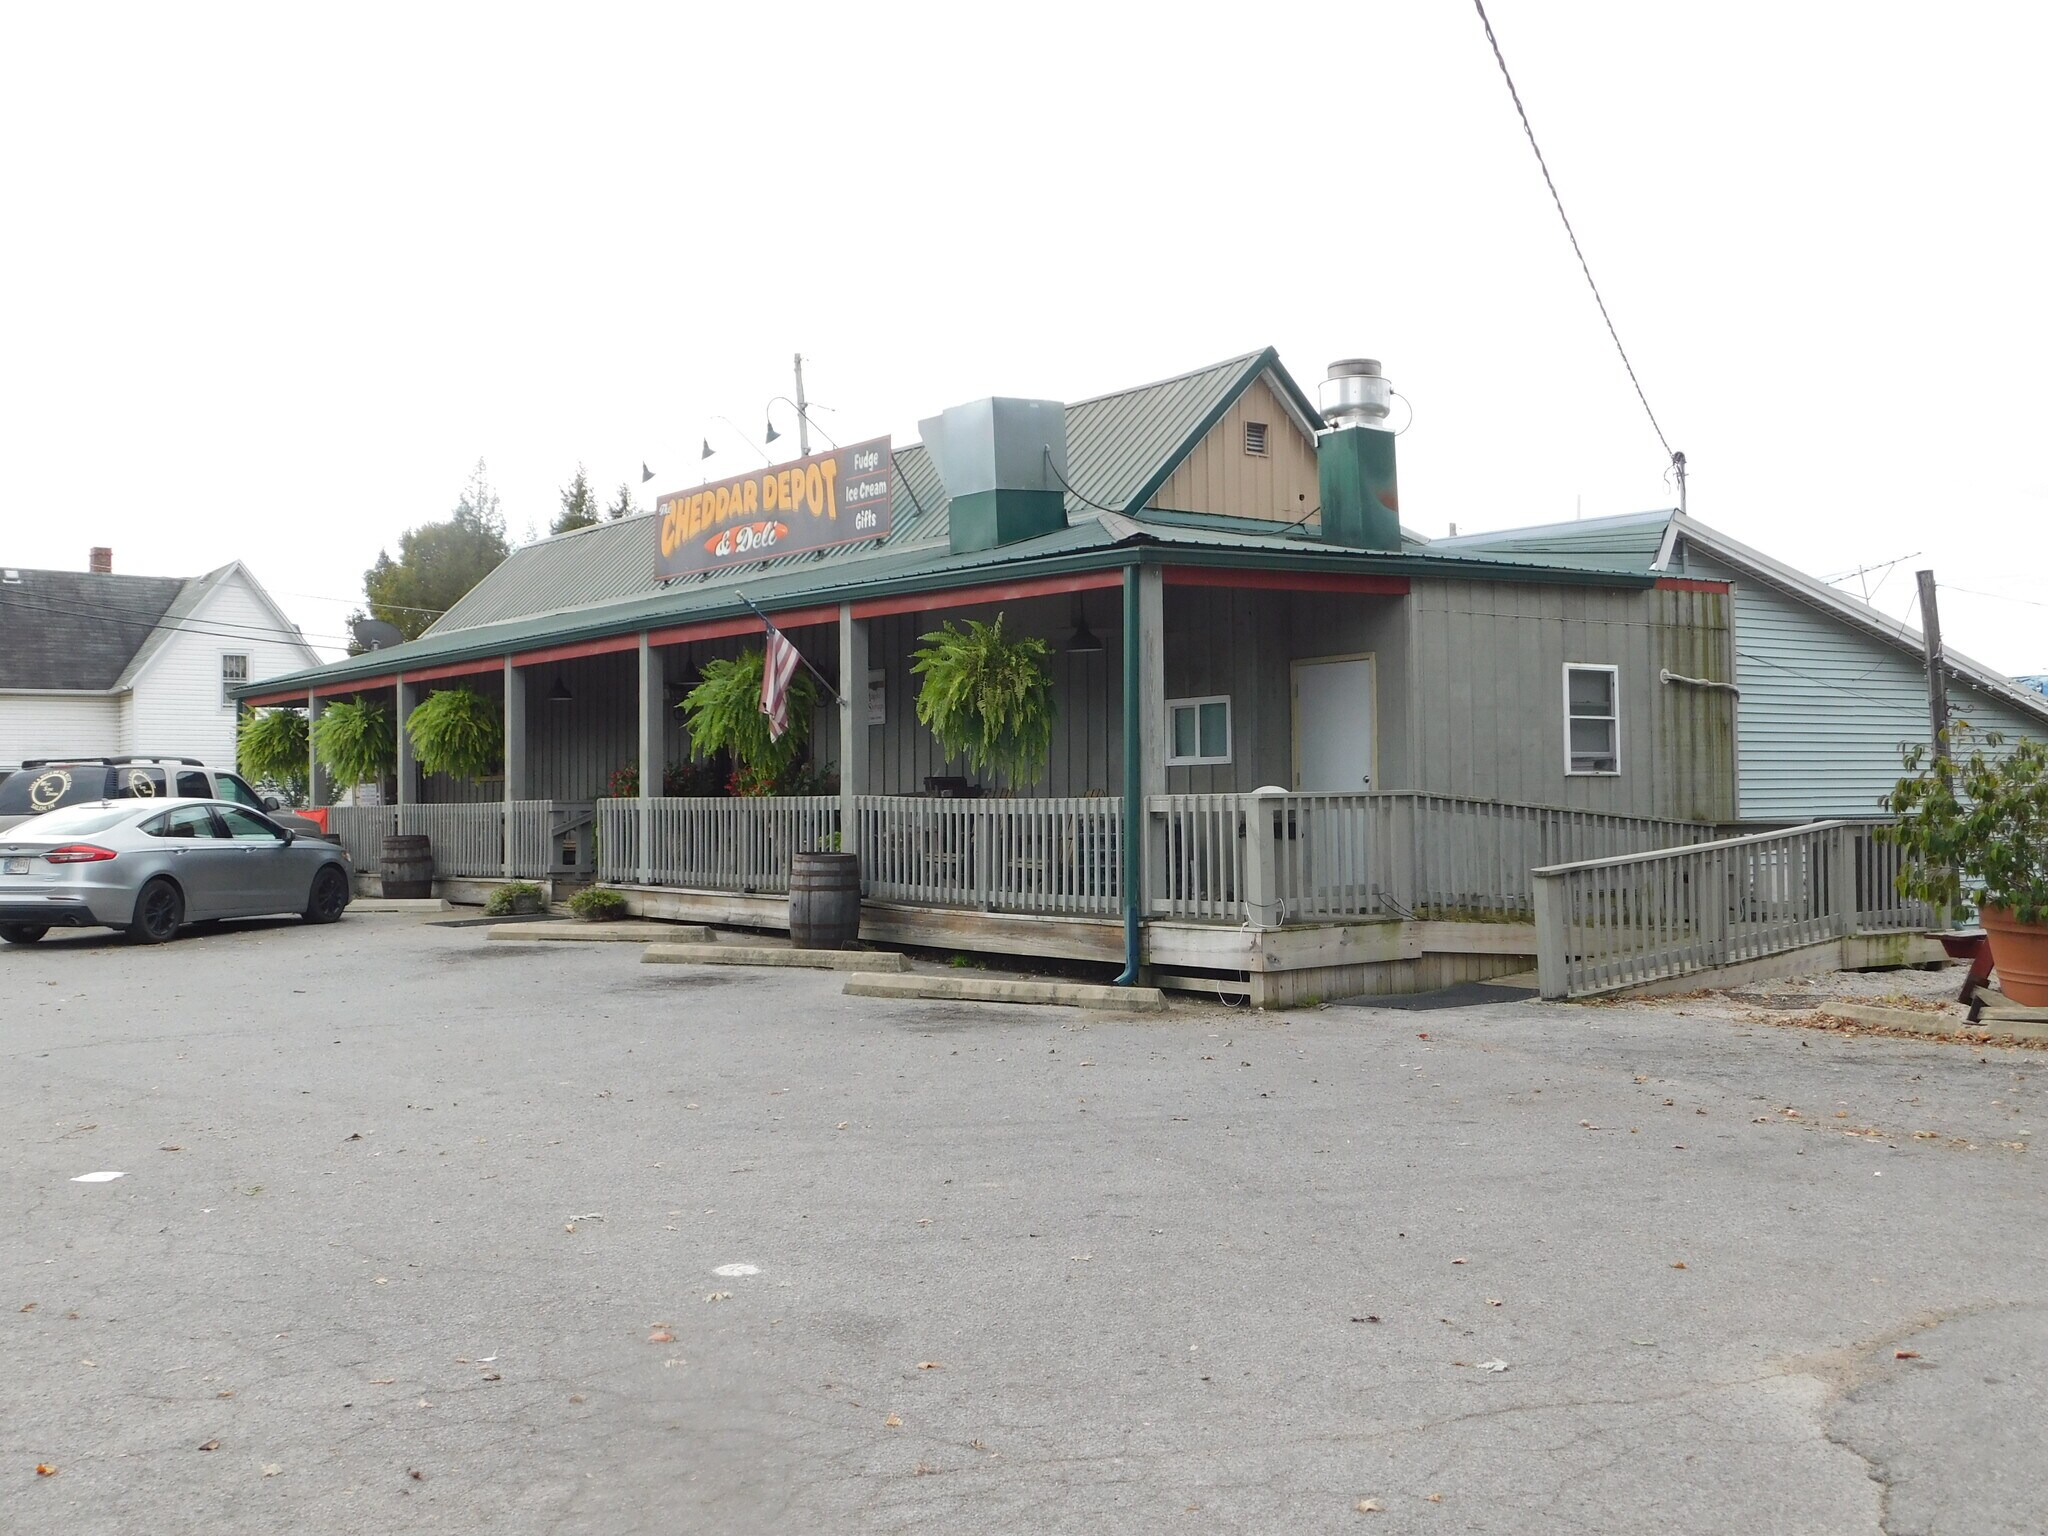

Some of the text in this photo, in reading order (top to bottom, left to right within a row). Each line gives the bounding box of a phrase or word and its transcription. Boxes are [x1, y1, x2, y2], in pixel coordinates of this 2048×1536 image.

[854, 450, 879, 472] Fudge
[845, 479, 887, 503] Ice Cream
[660, 458, 837, 558] CHEDDAR DEPOT
[855, 510, 877, 531] Gifts
[715, 521, 778, 557] & Deli
